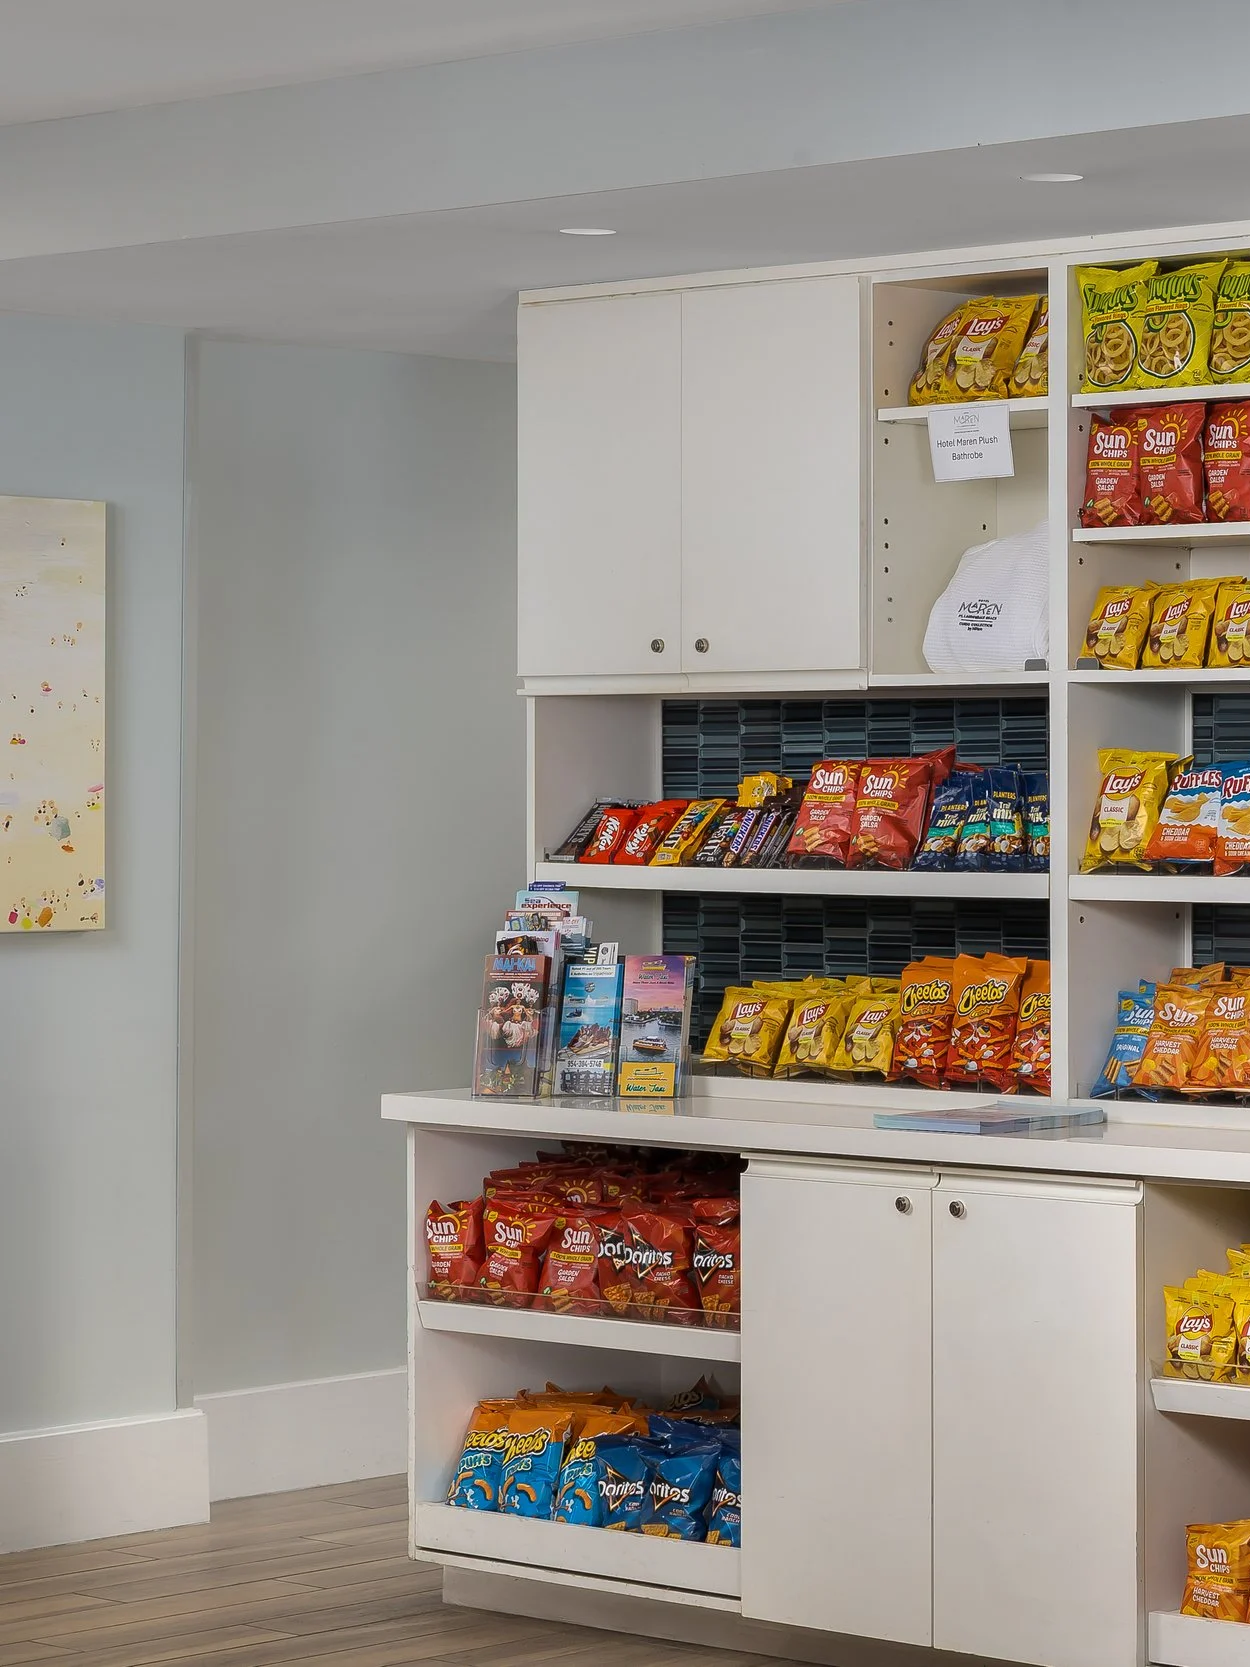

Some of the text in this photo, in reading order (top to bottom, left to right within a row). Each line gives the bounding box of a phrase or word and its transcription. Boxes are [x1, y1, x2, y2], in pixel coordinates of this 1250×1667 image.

[966, 317, 1004, 337] Lay's
[954, 414, 980, 425] MAREN
[936, 435, 998, 448] Hotel Maren Plush
[1144, 428, 1176, 451] Sun
[1208, 424, 1234, 444] Sun
[1094, 432, 1126, 455] Sun
[1214, 440, 1238, 448] CHIPS
[952, 451, 984, 461] Bathrobe
[1102, 450, 1128, 458] CHIPS
[1096, 478, 1118, 486] GARDEN
[1148, 474, 1166, 482] GARDEN
[1150, 480, 1164, 488] SALSA
[958, 602, 1003, 615] MAREN
[1105, 600, 1130, 618] Lay's
[1165, 600, 1190, 622] Lay's
[813, 769, 844, 789] Sun
[864, 775, 893, 795] Sun
[1104, 774, 1142, 794] Lay's
[1170, 770, 1222, 793] RUFFLES
[822, 785, 845, 793] CHIPS
[870, 790, 893, 798] CHIPS
[993, 791, 1016, 800] PLANTERS
[1028, 794, 1048, 802] PLANTERS
[968, 813, 986, 822] mix
[731, 809, 756, 853] SNICKERS
[751, 813, 776, 852] SNICKERS
[1162, 828, 1190, 836] CHEDDAR
[584, 947, 598, 964] VIP
[492, 958, 536, 972] MAI-KAI
[902, 979, 951, 1014] Cheetos
[958, 979, 1008, 1016] Cheetos
[736, 1002, 763, 1018] Lay's
[803, 1005, 826, 1024] Lay's
[1159, 1003, 1198, 1023] Sun
[1214, 996, 1245, 1018] Sun
[861, 1010, 888, 1024] Lay's
[1116, 1044, 1140, 1052] ORIGINAL
[626, 1084, 666, 1092] Water Taxi
[494, 1222, 522, 1243] Sun
[561, 1228, 590, 1248] Sun
[558, 1269, 580, 1277] GARDEN
[1180, 1316, 1211, 1332] Lay's
[459, 1454, 491, 1472] PUFFS
[650, 1482, 690, 1503] oritos
[1196, 1544, 1228, 1568] Sun
[1193, 1587, 1220, 1599] HARVEST
[1192, 1595, 1220, 1608] CHEDDAR
